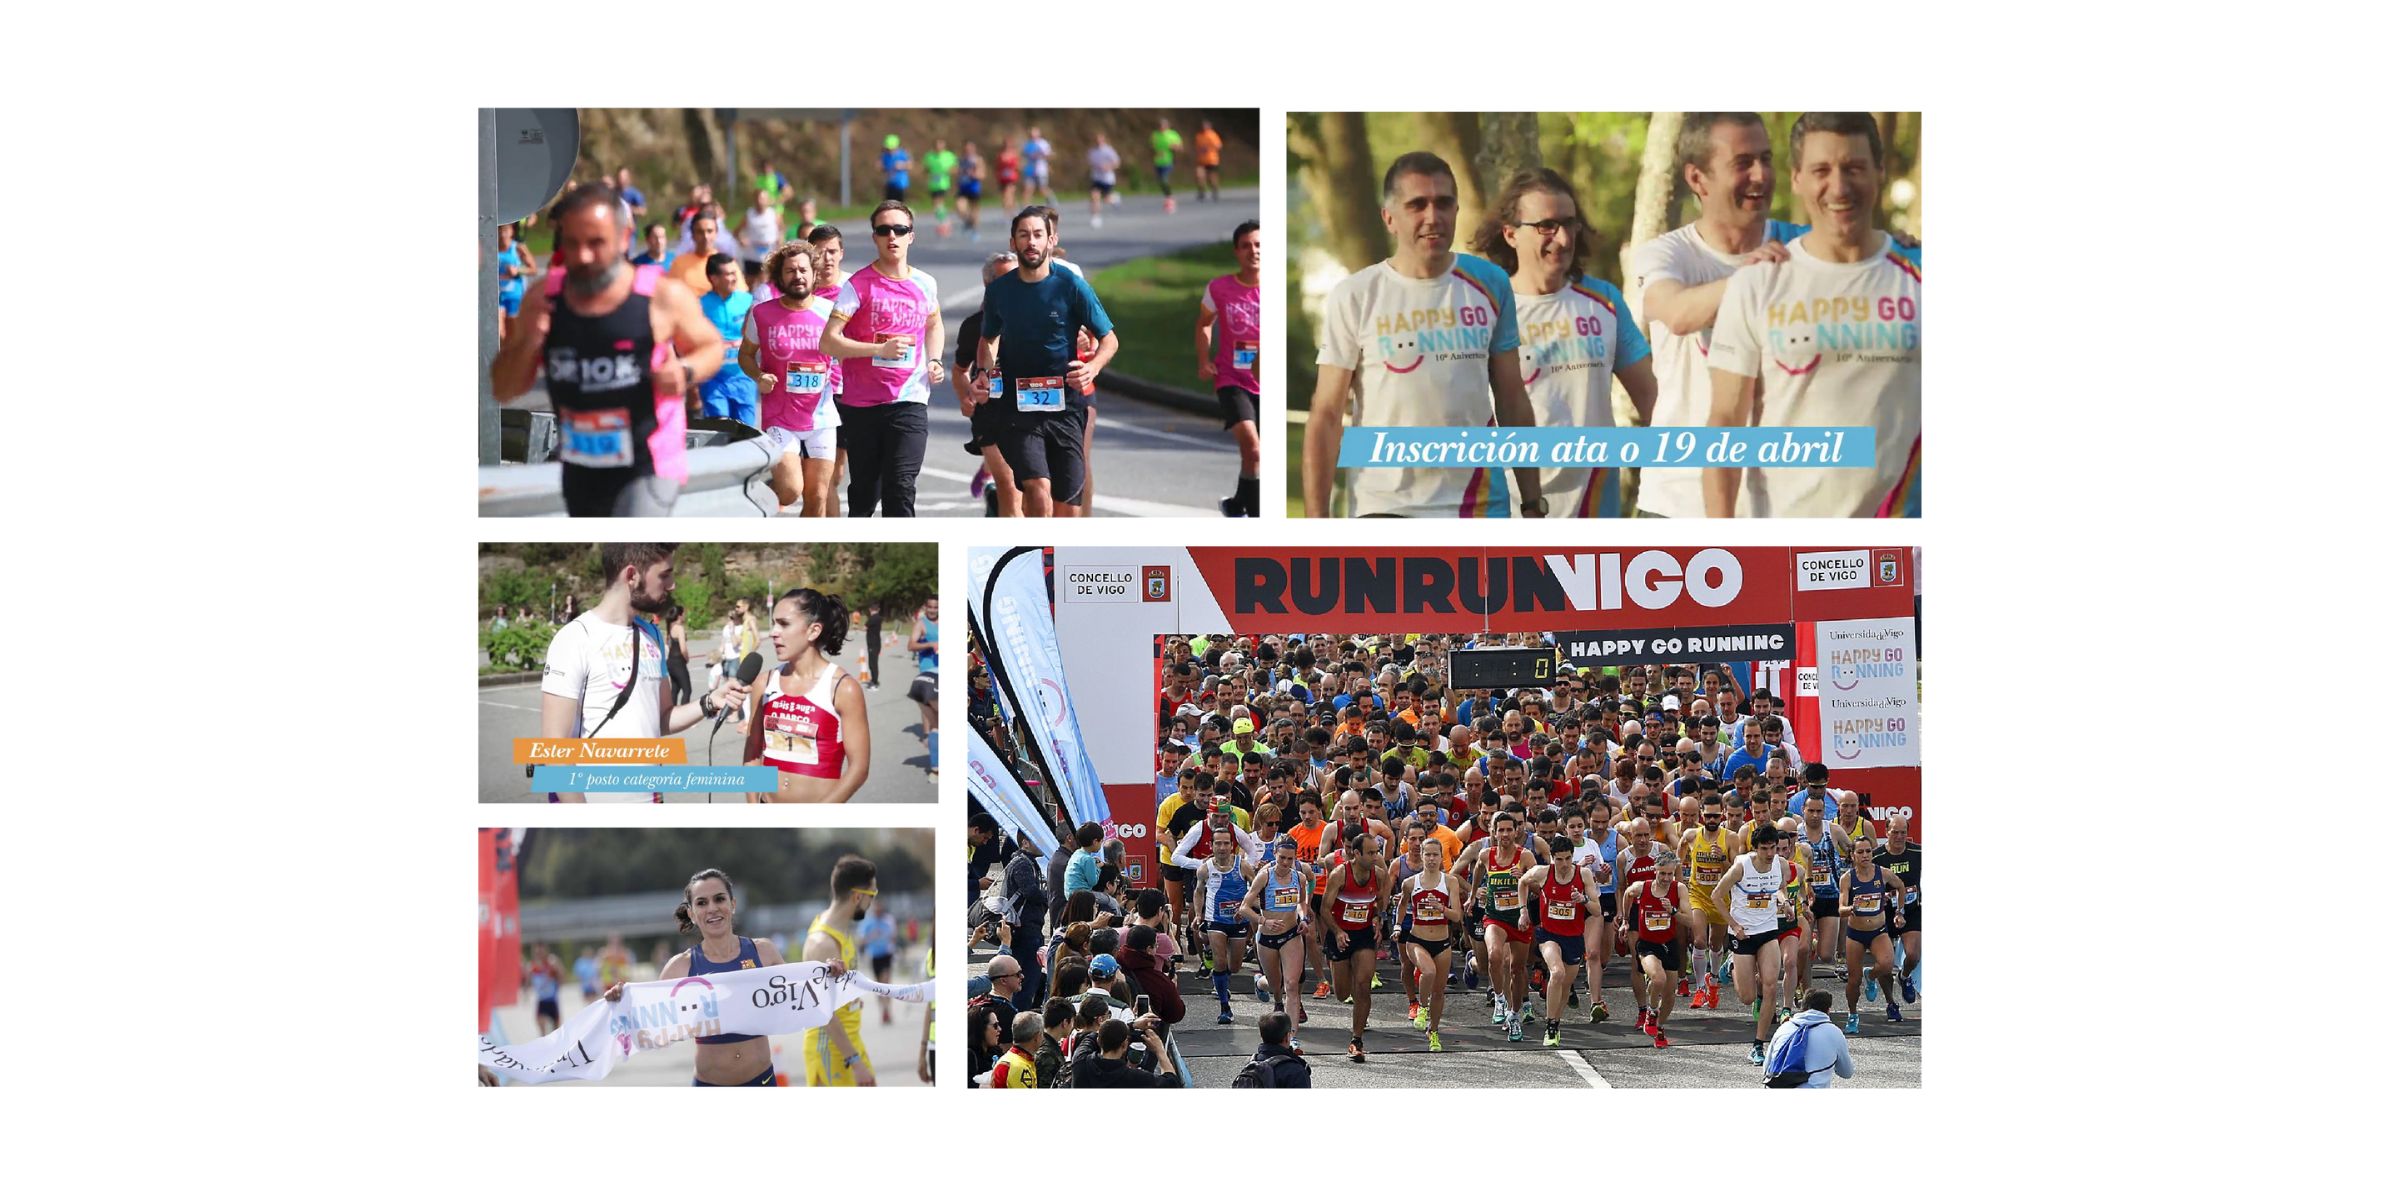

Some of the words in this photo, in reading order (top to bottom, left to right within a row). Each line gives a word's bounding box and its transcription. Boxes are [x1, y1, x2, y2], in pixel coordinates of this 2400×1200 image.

[1767, 295, 1871, 327] HAPPY
[1878, 295, 1916, 322] GO
[1376, 306, 1458, 337] HAPPY
[1459, 305, 1488, 327] GO
[1576, 316, 1602, 336] GO
[794, 374, 819, 388] 318
[1031, 391, 1050, 405] 32
[1802, 558, 1864, 570] CONCELLO
[1069, 573, 1133, 583] CONCELLO
[1810, 572, 1825, 582] DE
[1829, 570, 1857, 581] VIGO
[1077, 585, 1093, 595] DE
[1097, 585, 1126, 595] VIGO
[1571, 639, 1646, 657] HAPPY
[1651, 637, 1683, 654] GO
[1687, 634, 1784, 653] RUNNING
[1831, 648, 1881, 665] HAPPY
[1884, 647, 1903, 662] GO
[1534, 658, 1549, 680] 0
[1833, 717, 1883, 735] HAPPY
[1886, 717, 1906, 733] GO
[752, 975, 821, 1011] Vigo
